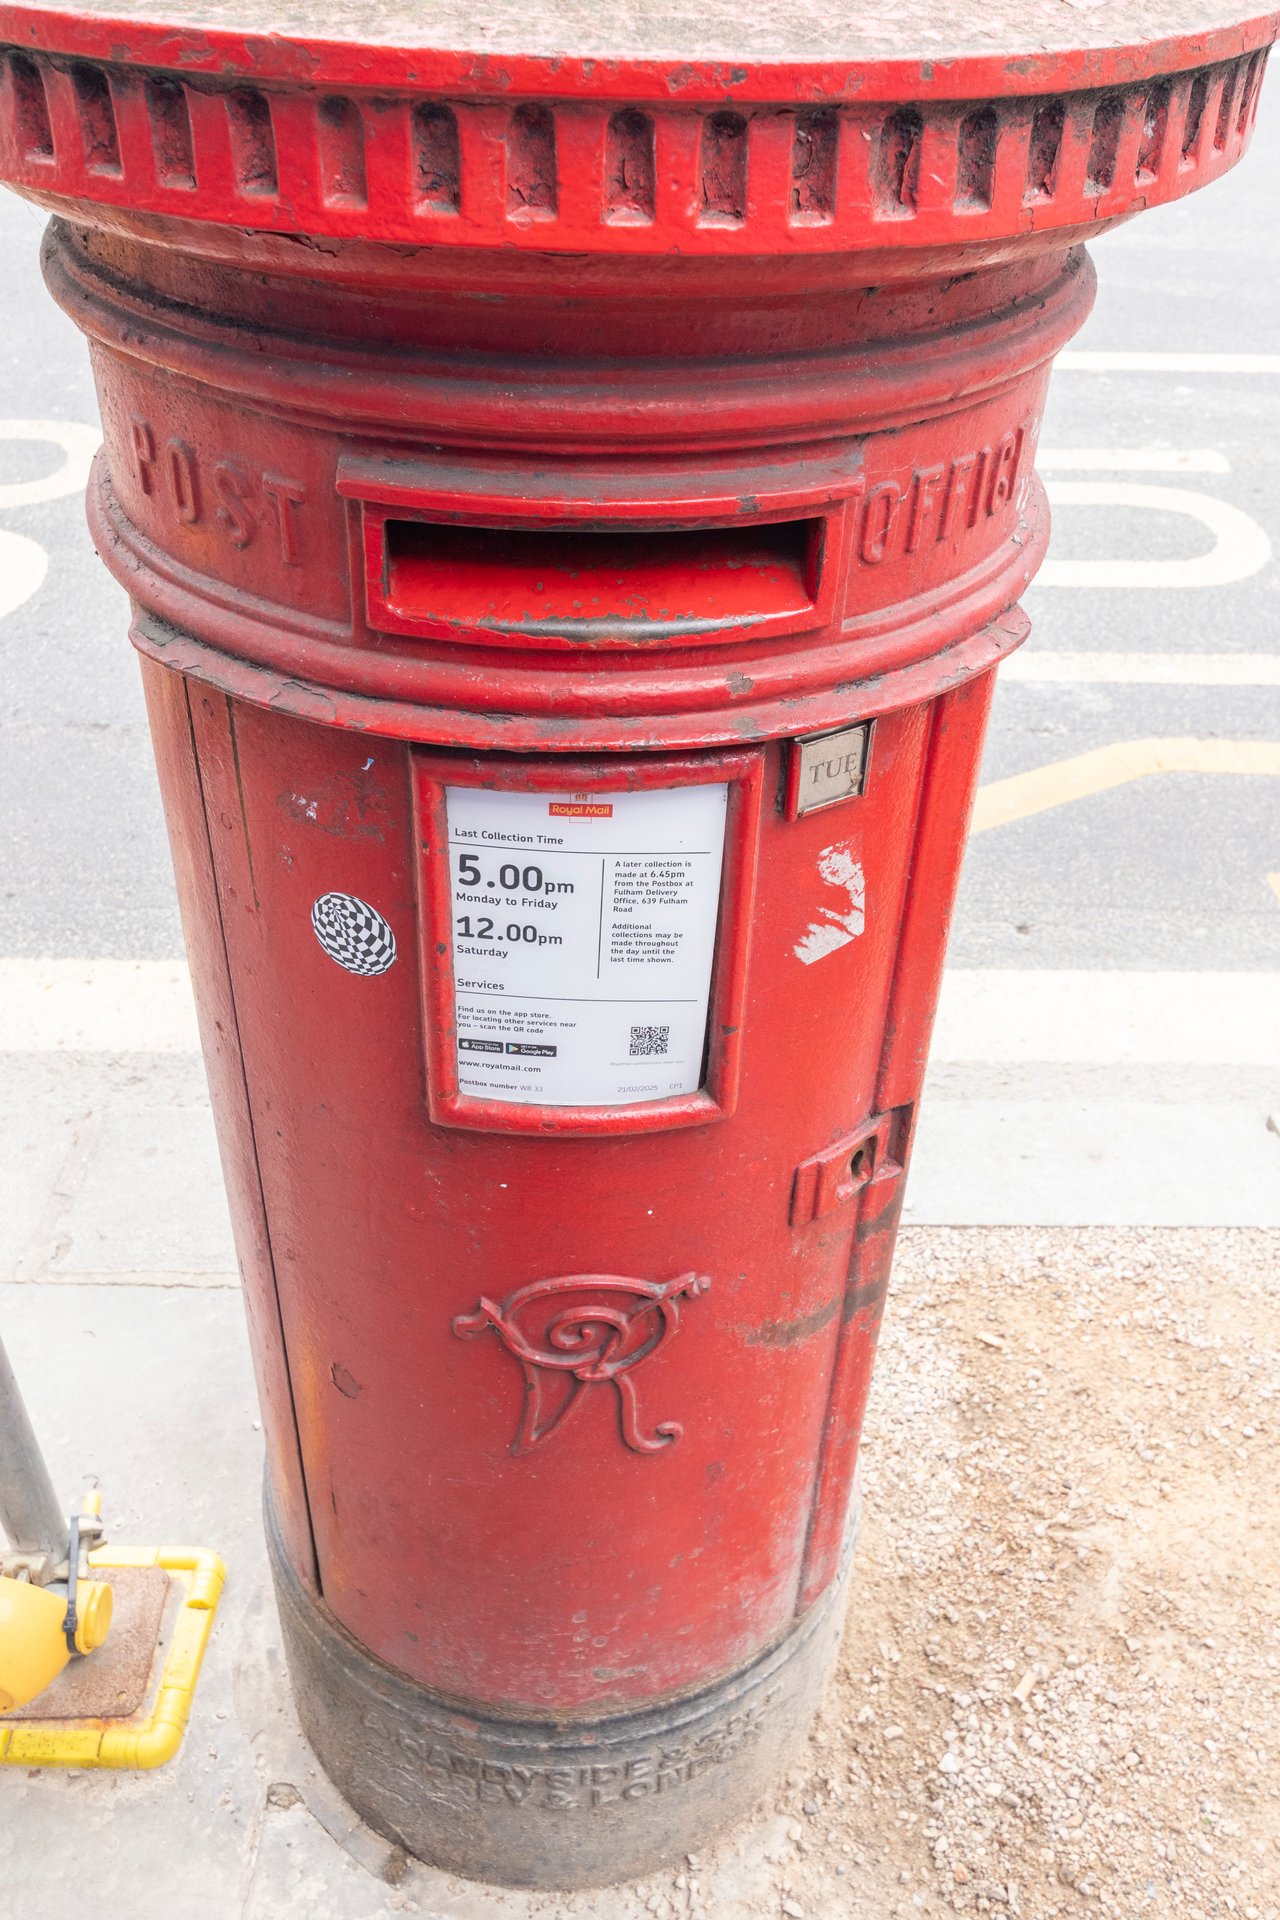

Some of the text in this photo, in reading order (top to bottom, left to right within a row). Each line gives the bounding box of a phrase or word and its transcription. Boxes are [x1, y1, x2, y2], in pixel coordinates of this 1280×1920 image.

[130, 411, 304, 568] POST
[809, 752, 858, 784] TUE
[552, 804, 610, 816] Royal Mail
[455, 827, 564, 845] Last Collection Time
[614, 860, 621, 868] A
[644, 860, 682, 868] collection
[684, 860, 692, 868] is
[458, 853, 574, 895] 5.00pm
[650, 870, 685, 879] 6.45pm
[645, 889, 678, 897] Delivery
[456, 892, 558, 910] Monday to Friday
[456, 915, 563, 946] 12.00pm
[635, 940, 679, 948] throughout
[457, 944, 509, 959] Saturday
[457, 978, 505, 990] Services
[457, 1005, 474, 1013] Find
[472, 1014, 501, 1024] locating
[526, 1019, 557, 1027] services
[458, 1060, 541, 1073] www.royalmail.com
[459, 1078, 487, 1087] Postbox
[489, 1081, 518, 1090] number
[617, 1085, 658, 1093] 21/02/2025
